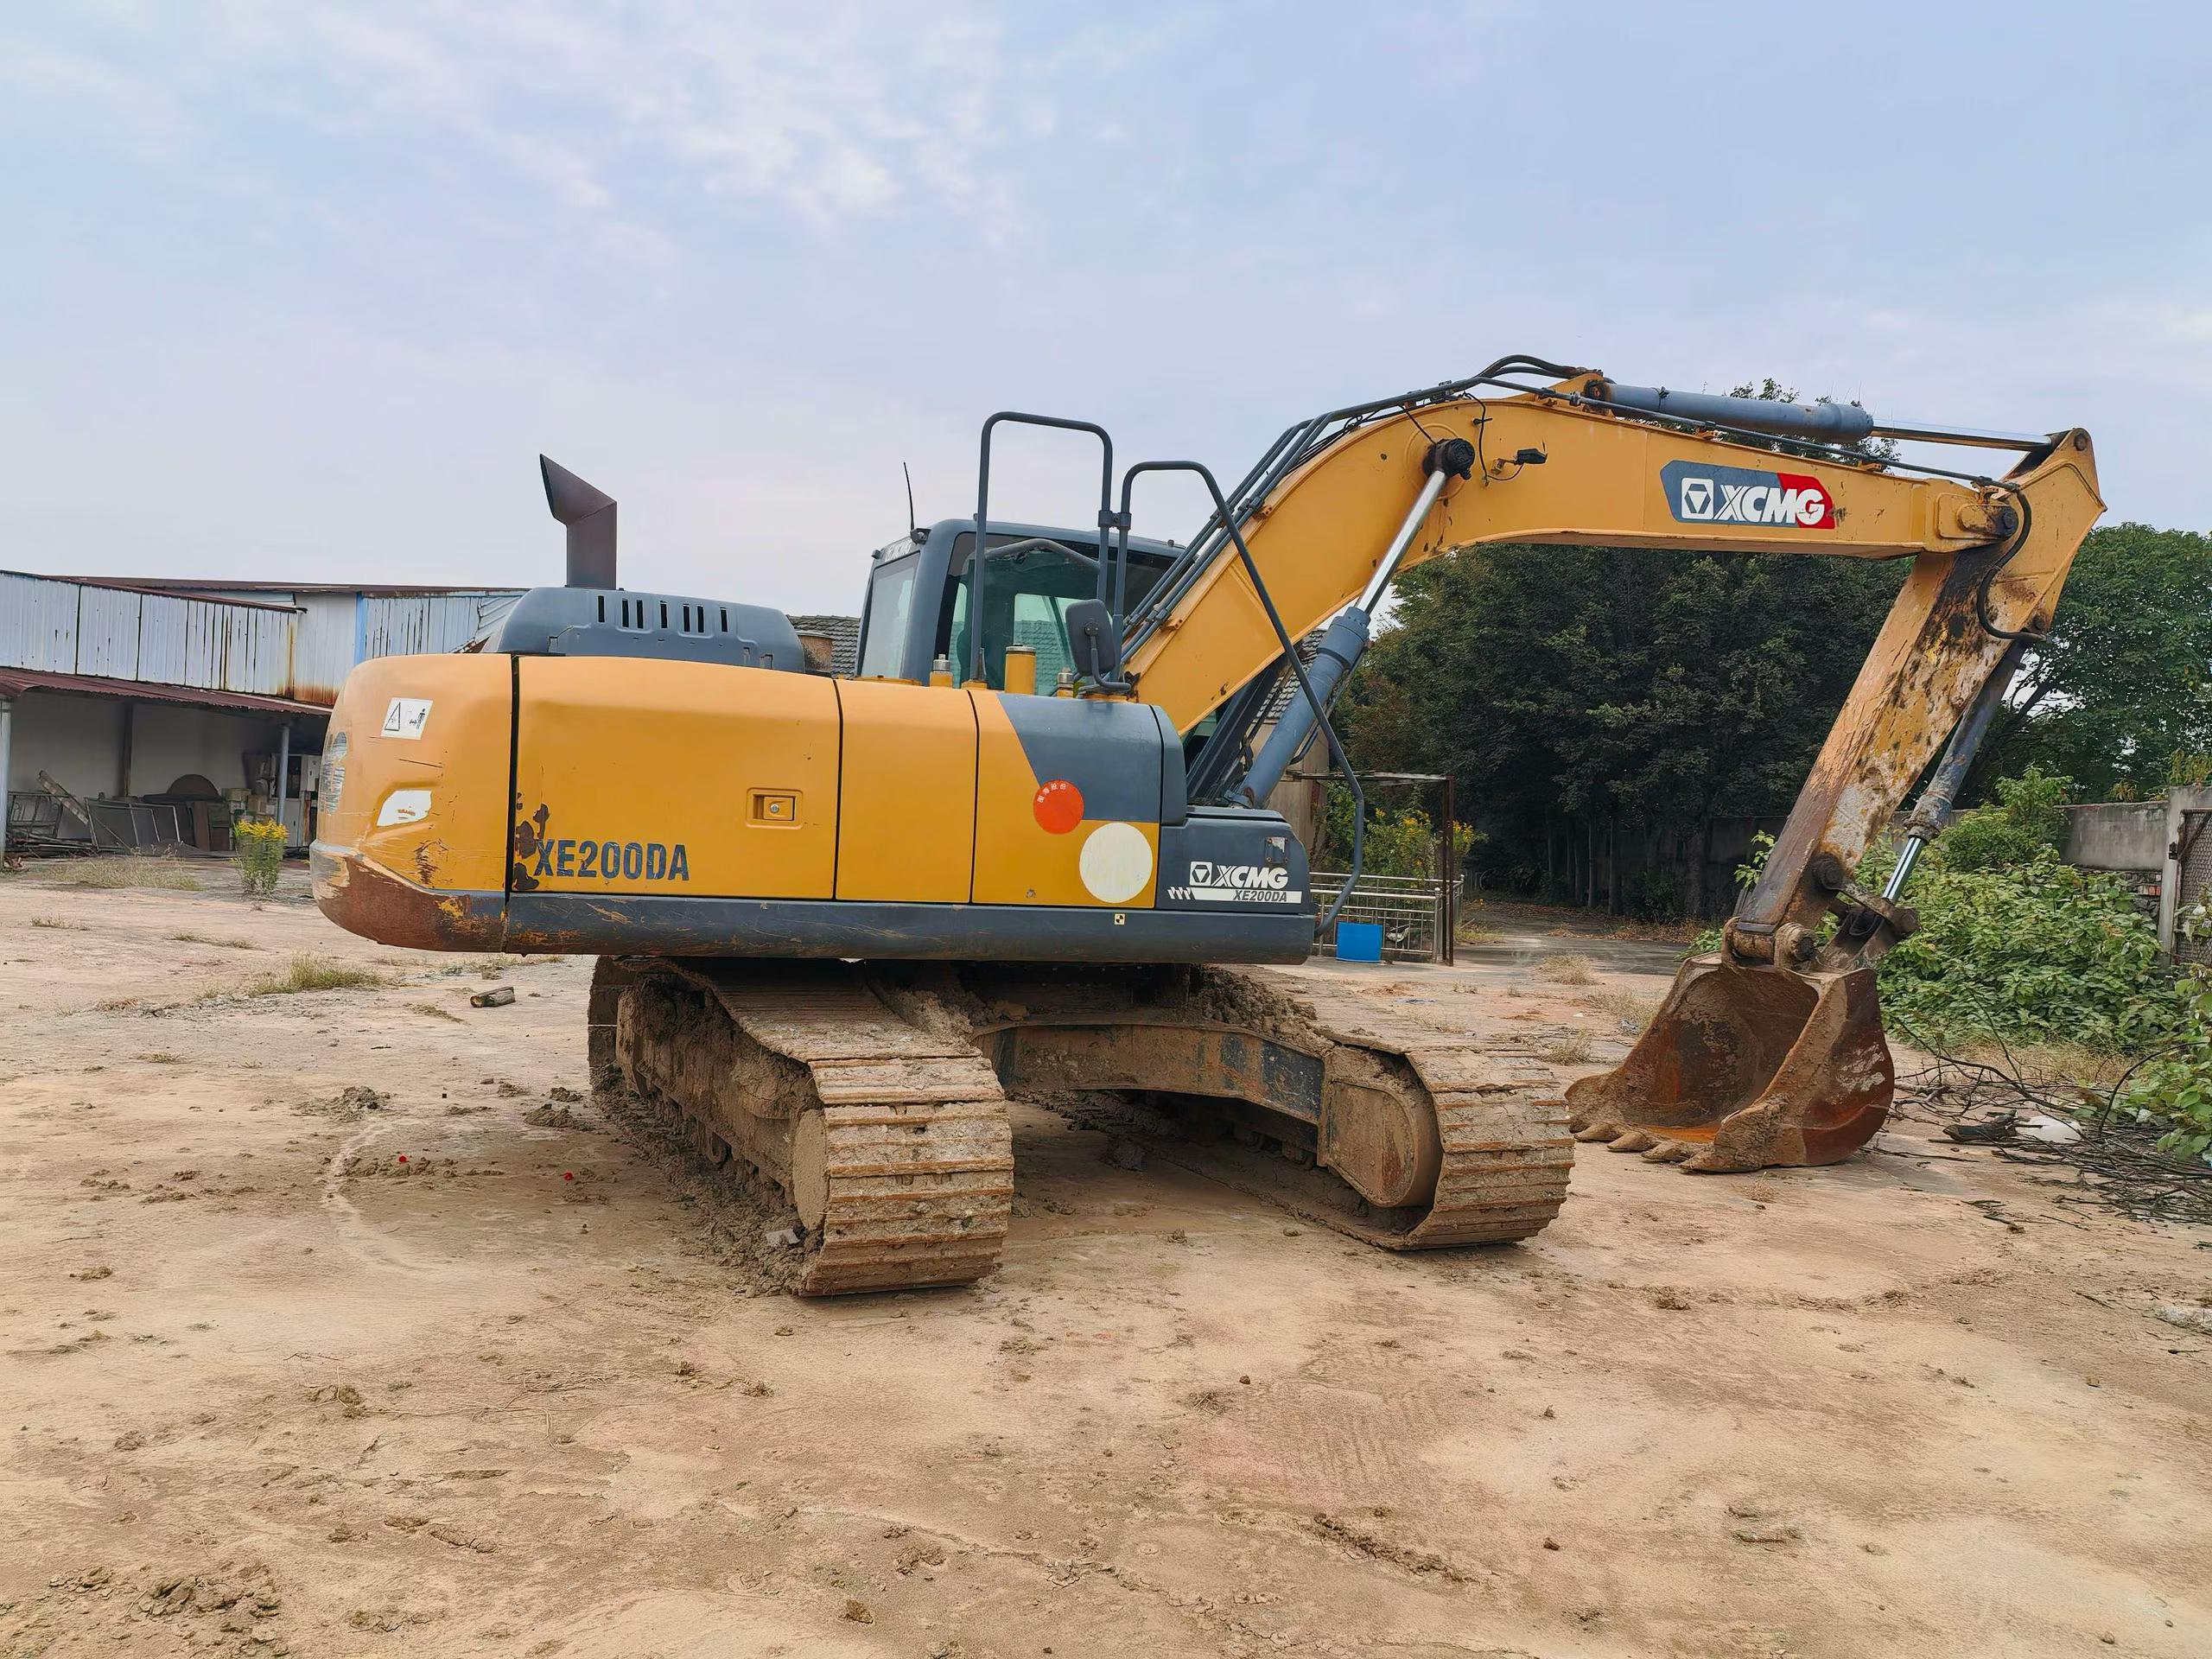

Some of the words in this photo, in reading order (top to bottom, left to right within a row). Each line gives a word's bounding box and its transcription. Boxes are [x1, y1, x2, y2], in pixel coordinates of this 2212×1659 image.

[1713, 484, 1825, 525] XCMG
[533, 838, 690, 881] XE200DA
[1211, 865, 1288, 890] XCMG
[1233, 890, 1287, 903] XE200DA
